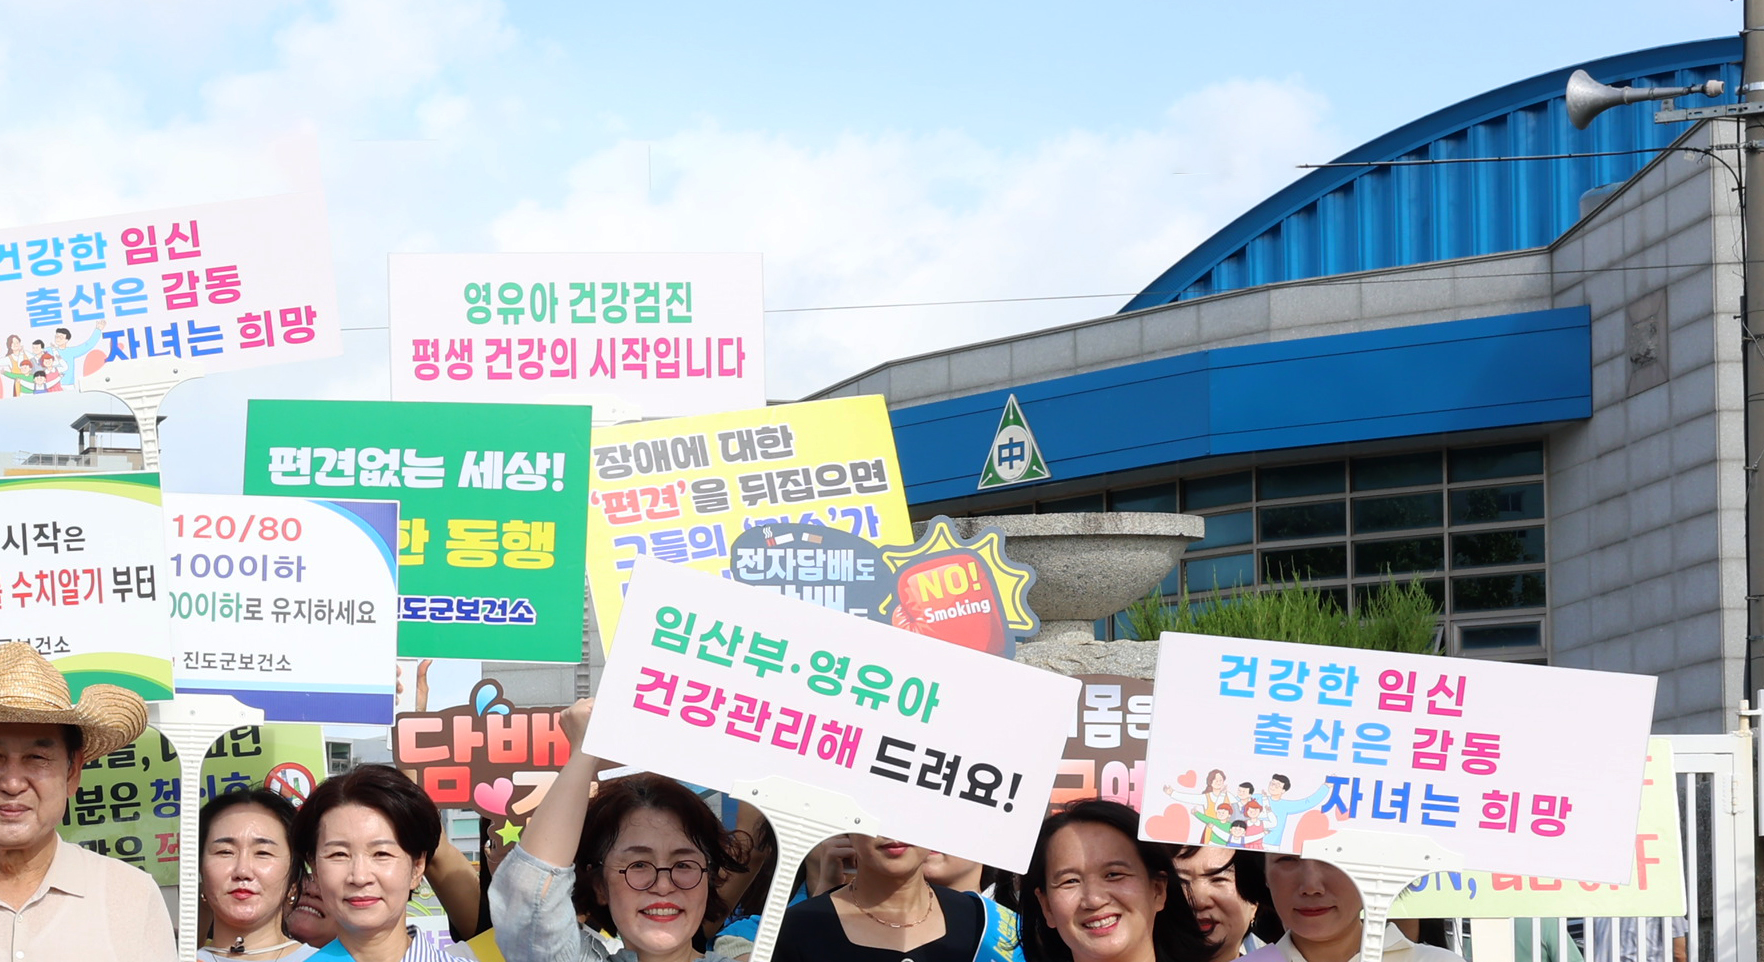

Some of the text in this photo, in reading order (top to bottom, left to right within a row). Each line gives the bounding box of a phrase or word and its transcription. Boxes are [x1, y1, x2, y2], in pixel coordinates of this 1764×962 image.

[120, 220, 202, 266] 임신
[25, 264, 242, 328] 출산은 감동
[463, 281, 693, 325] 영유아 건강검진
[102, 305, 318, 363] 자녀는 희망
[412, 336, 746, 381] 평생 건강의 시작입니다
[268, 446, 566, 492] 편견없는 세상!
[593, 424, 794, 480] 장애에 대한
[997, 436, 1025, 470] 中
[739, 457, 890, 507] 뒤집으면
[1, 520, 86, 557] 시작은
[172, 514, 303, 544] 120/80
[445, 519, 556, 570] 동행
[11, 566, 104, 610] 수치알기
[112, 564, 157, 604] 부터
[169, 553, 307, 583] 100이하
[736, 548, 876, 582] 전자담배도
[916, 560, 981, 604] NO!
[270, 596, 376, 627] 유지하세요
[397, 596, 535, 624] 도군보건소
[924, 596, 992, 624] Smoking
[182, 650, 293, 673] 진도군보건소
[651, 606, 940, 724] 임산부·영유아
[1218, 652, 1467, 718] 건강한 임신
[633, 666, 1023, 814] 건강관리해 드려요!
[1253, 712, 1502, 776] 출산은 감동
[1320, 773, 1573, 838] 자녀는 희망
